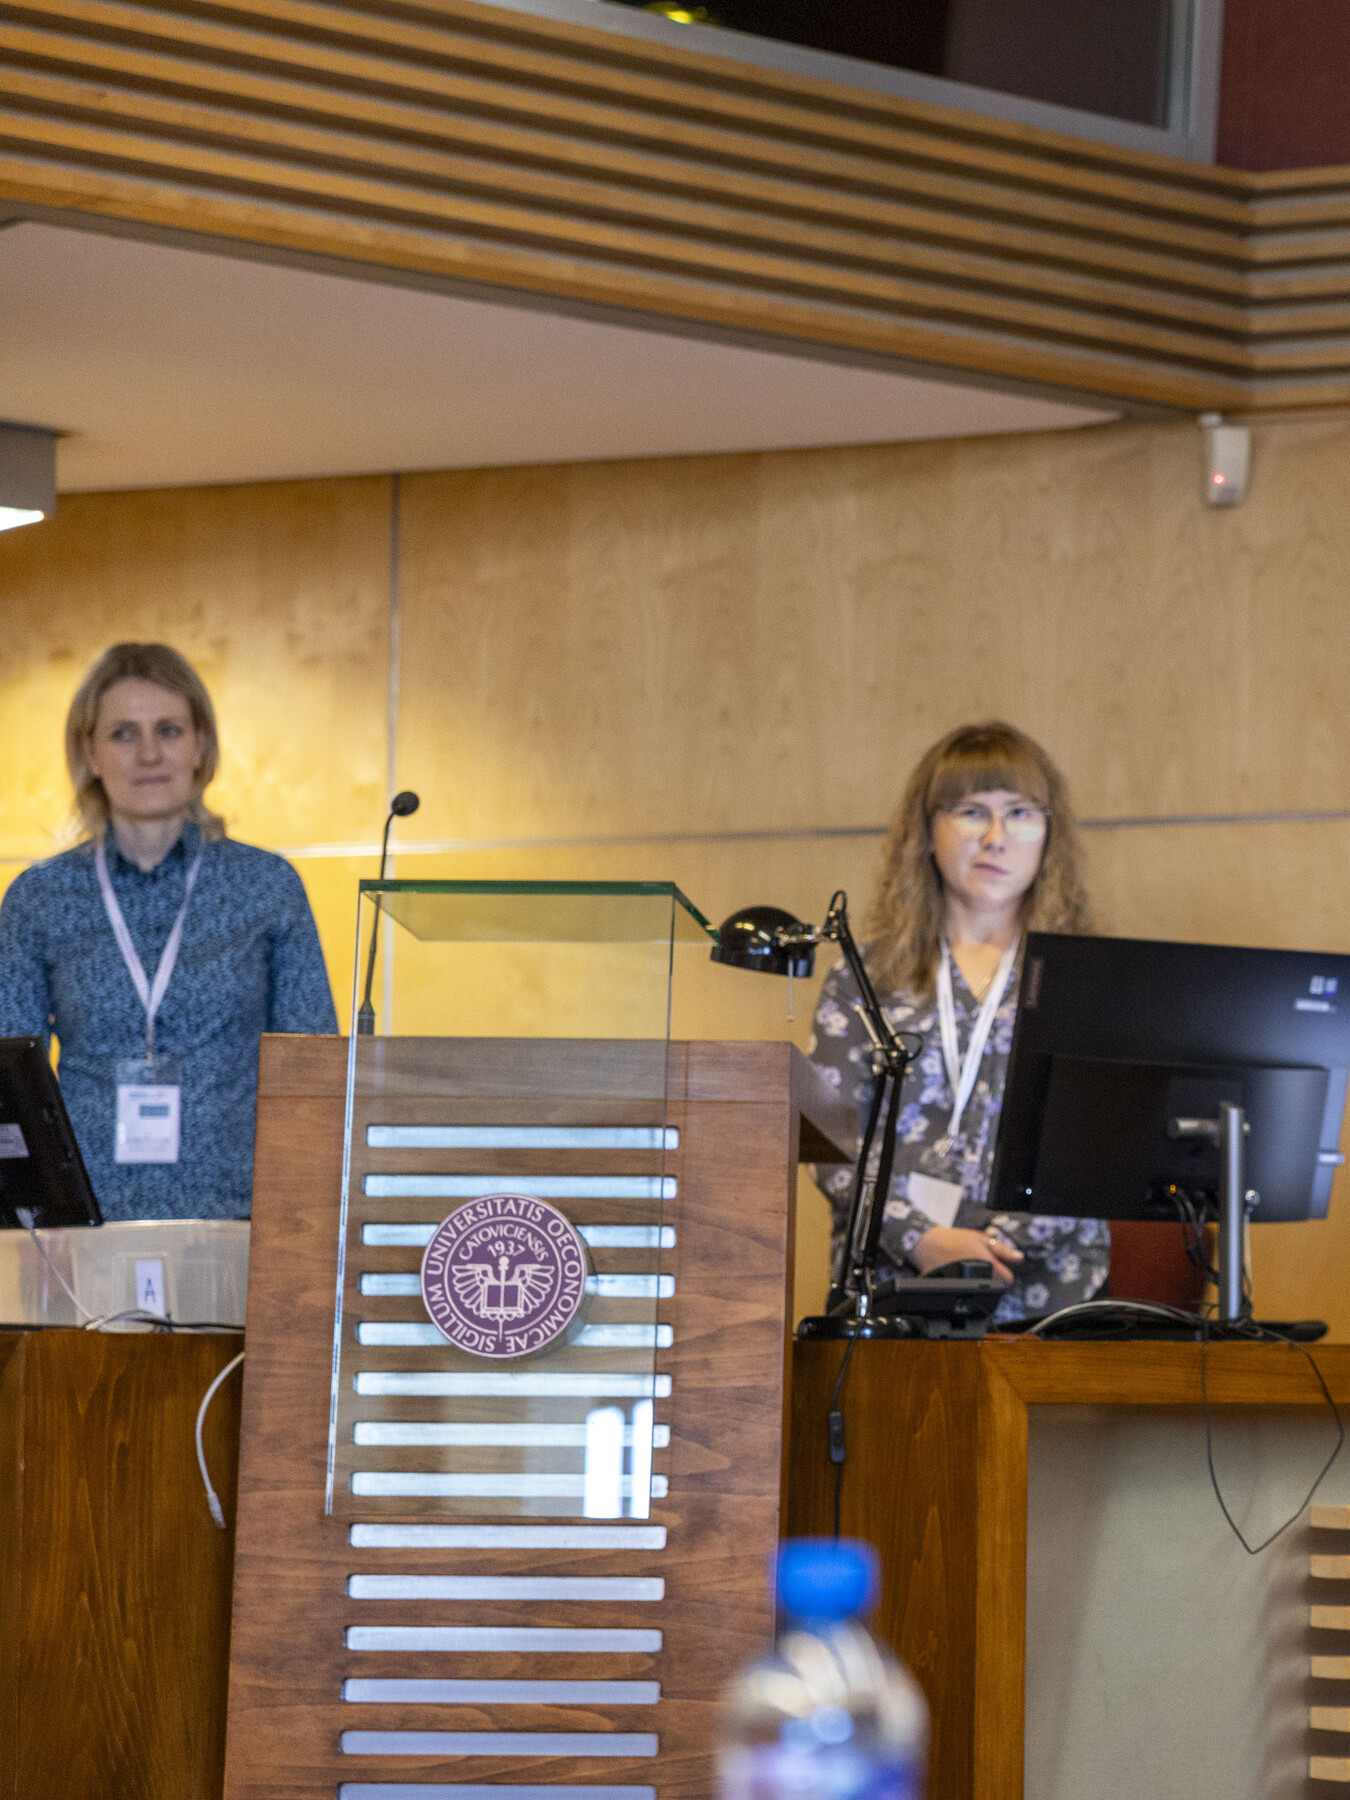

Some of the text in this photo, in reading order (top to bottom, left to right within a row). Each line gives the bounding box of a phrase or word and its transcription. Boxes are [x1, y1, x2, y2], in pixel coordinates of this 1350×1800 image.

[458, 1223, 550, 1262] CATOVICIENSIS
[486, 1240, 526, 1258] 1937
[144, 1277, 157, 1304] A
[426, 1198, 582, 1353] SIGILLUM UNIVERSITATIS OECONOMICAE
